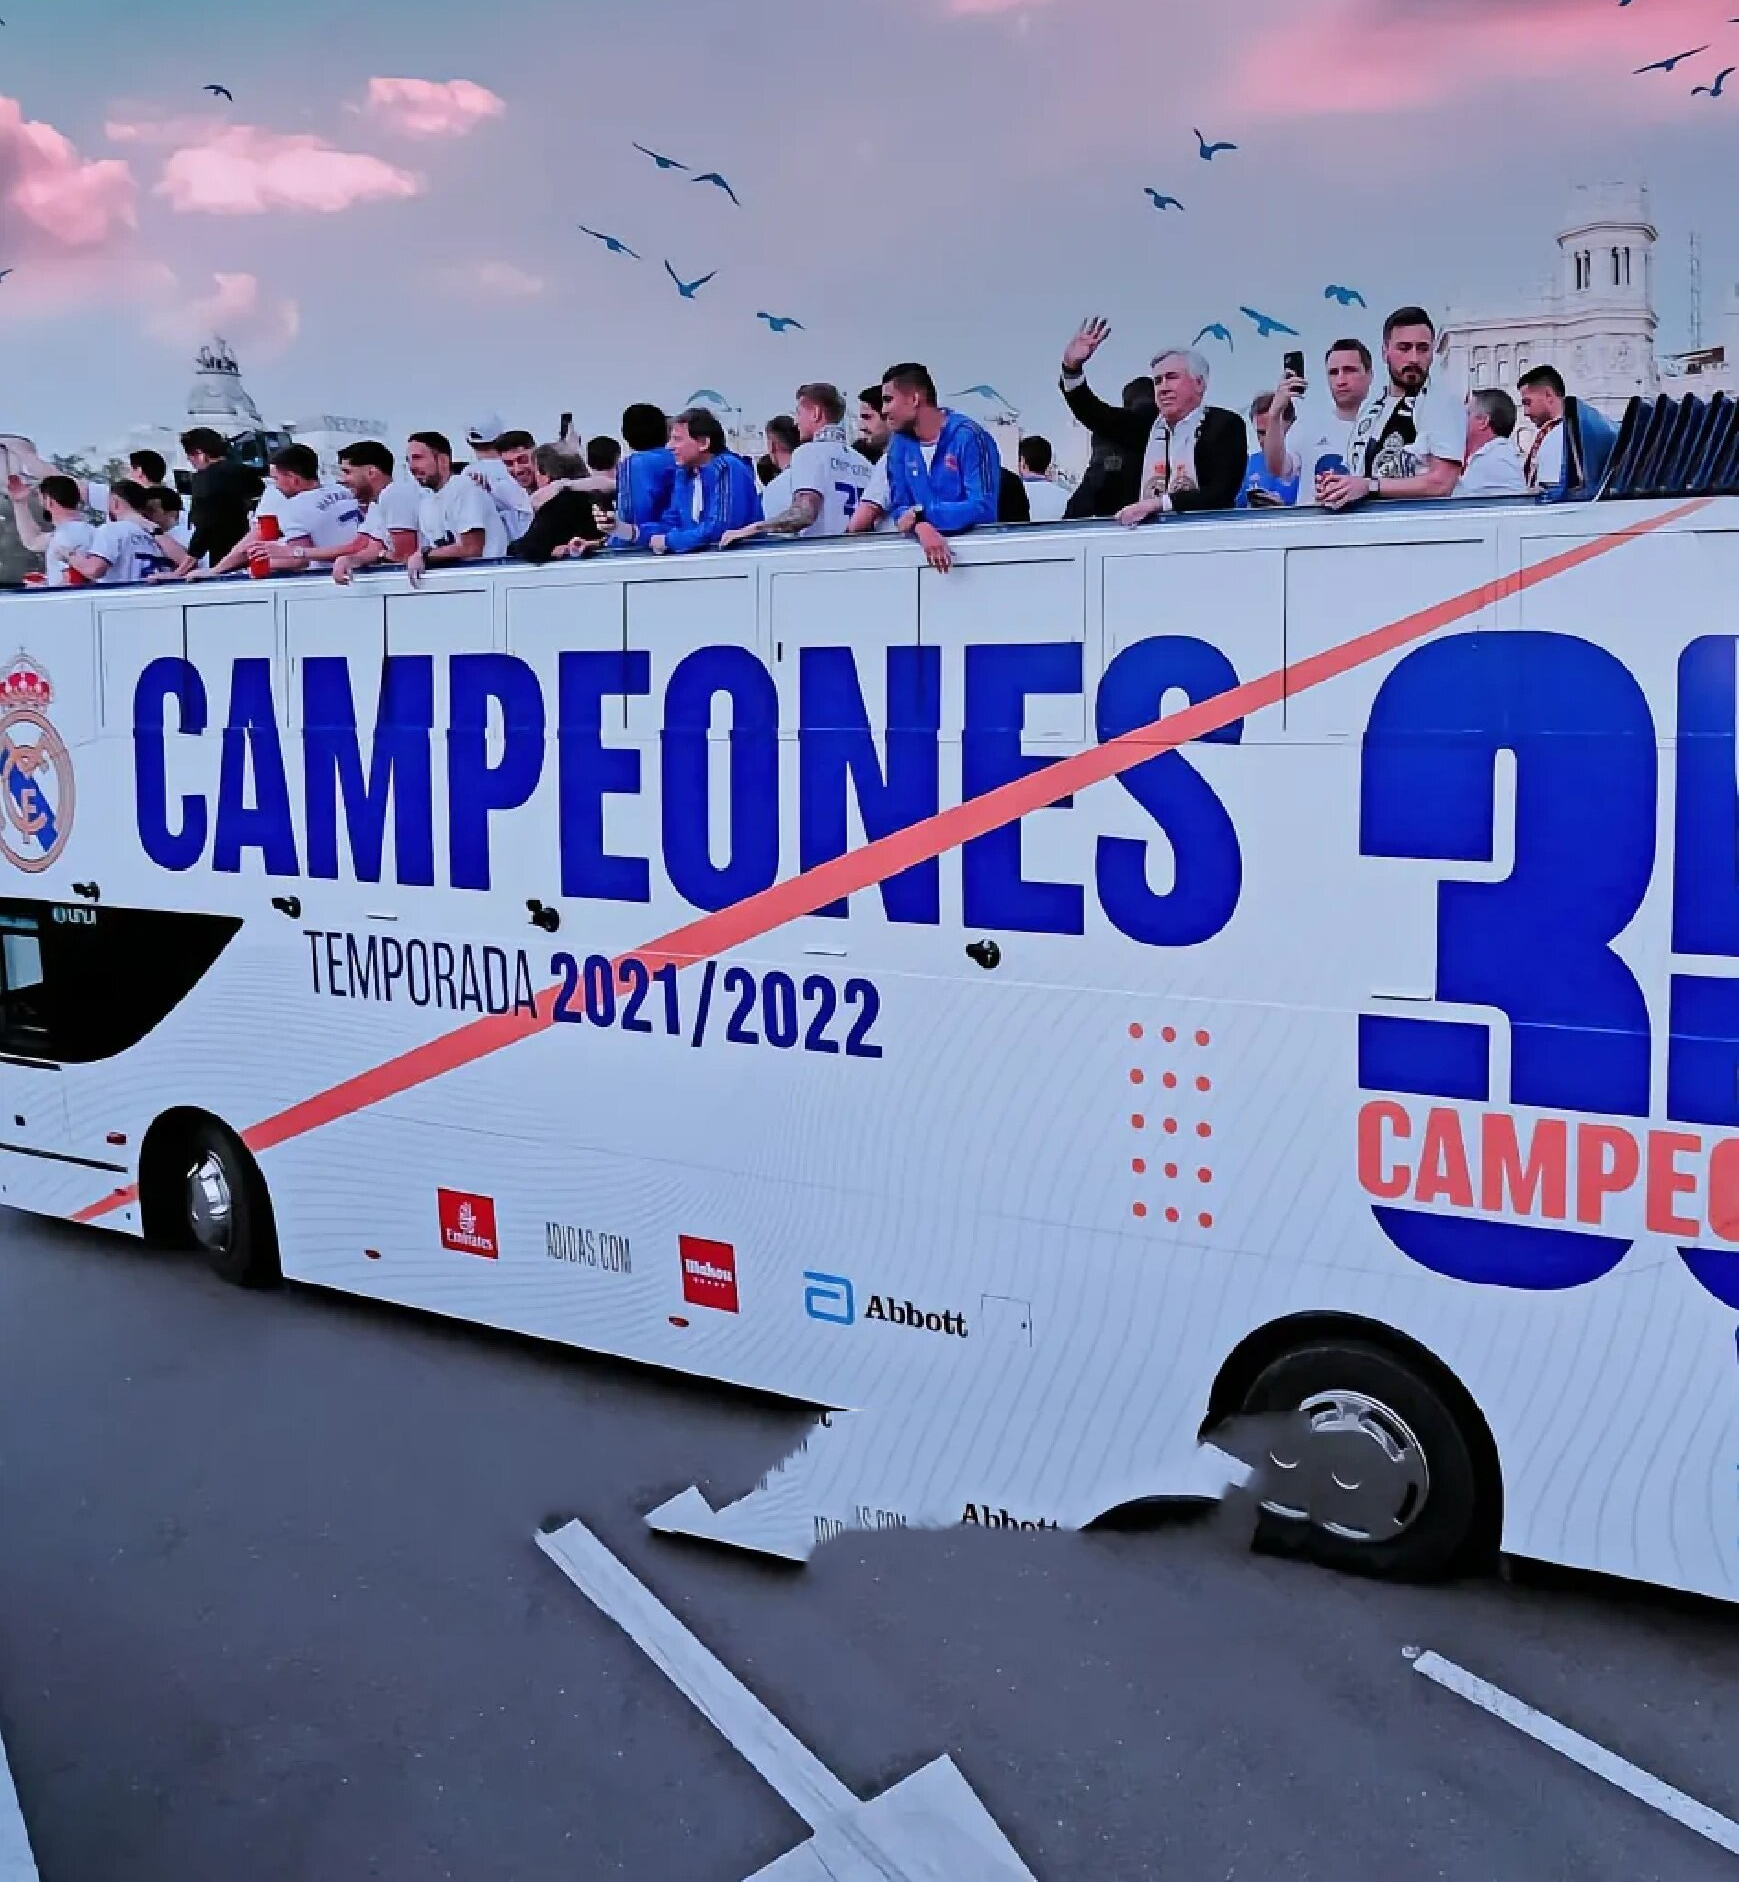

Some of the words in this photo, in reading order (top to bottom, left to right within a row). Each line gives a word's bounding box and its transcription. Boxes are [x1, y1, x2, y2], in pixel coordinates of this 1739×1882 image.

[133, 635, 1243, 947] CAMPEONES
[304, 930, 538, 1019] TEMPORADA
[551, 951, 883, 1059] 2021/2022
[1358, 630, 1739, 1310] 3
[446, 1228, 494, 1251] Emirates
[864, 1294, 969, 1339] Abbott
